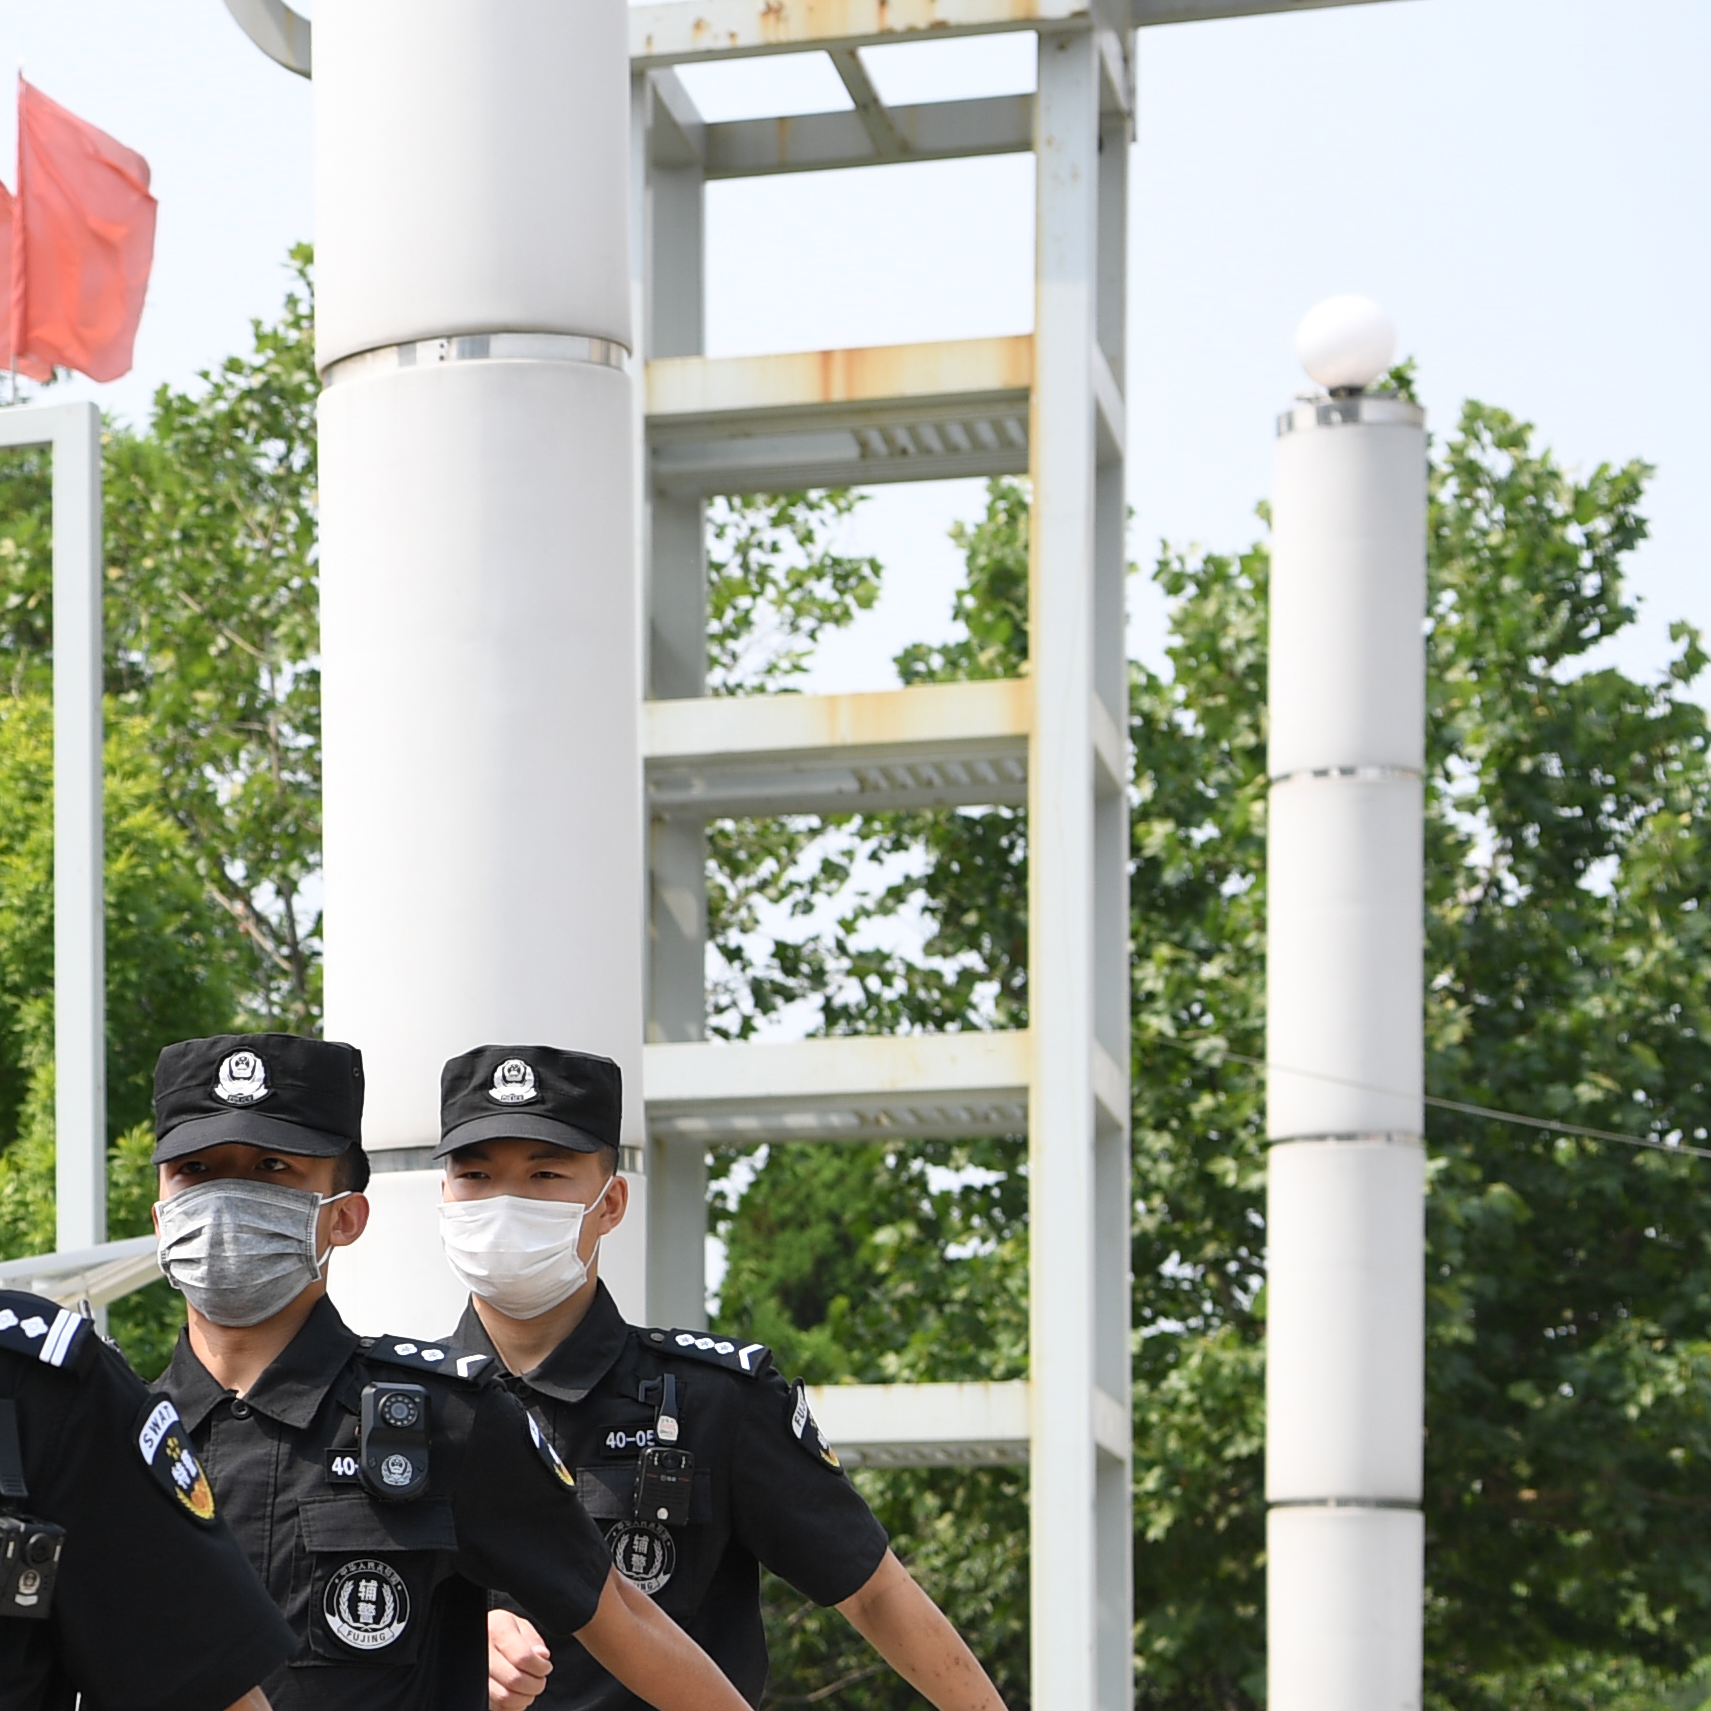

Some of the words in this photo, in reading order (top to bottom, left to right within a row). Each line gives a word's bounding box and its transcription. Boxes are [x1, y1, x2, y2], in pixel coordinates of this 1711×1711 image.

[143, 1405, 173, 1449] SWAT
[357, 1579, 379, 1624] 辅警
[346, 1630, 387, 1644] FUJING
